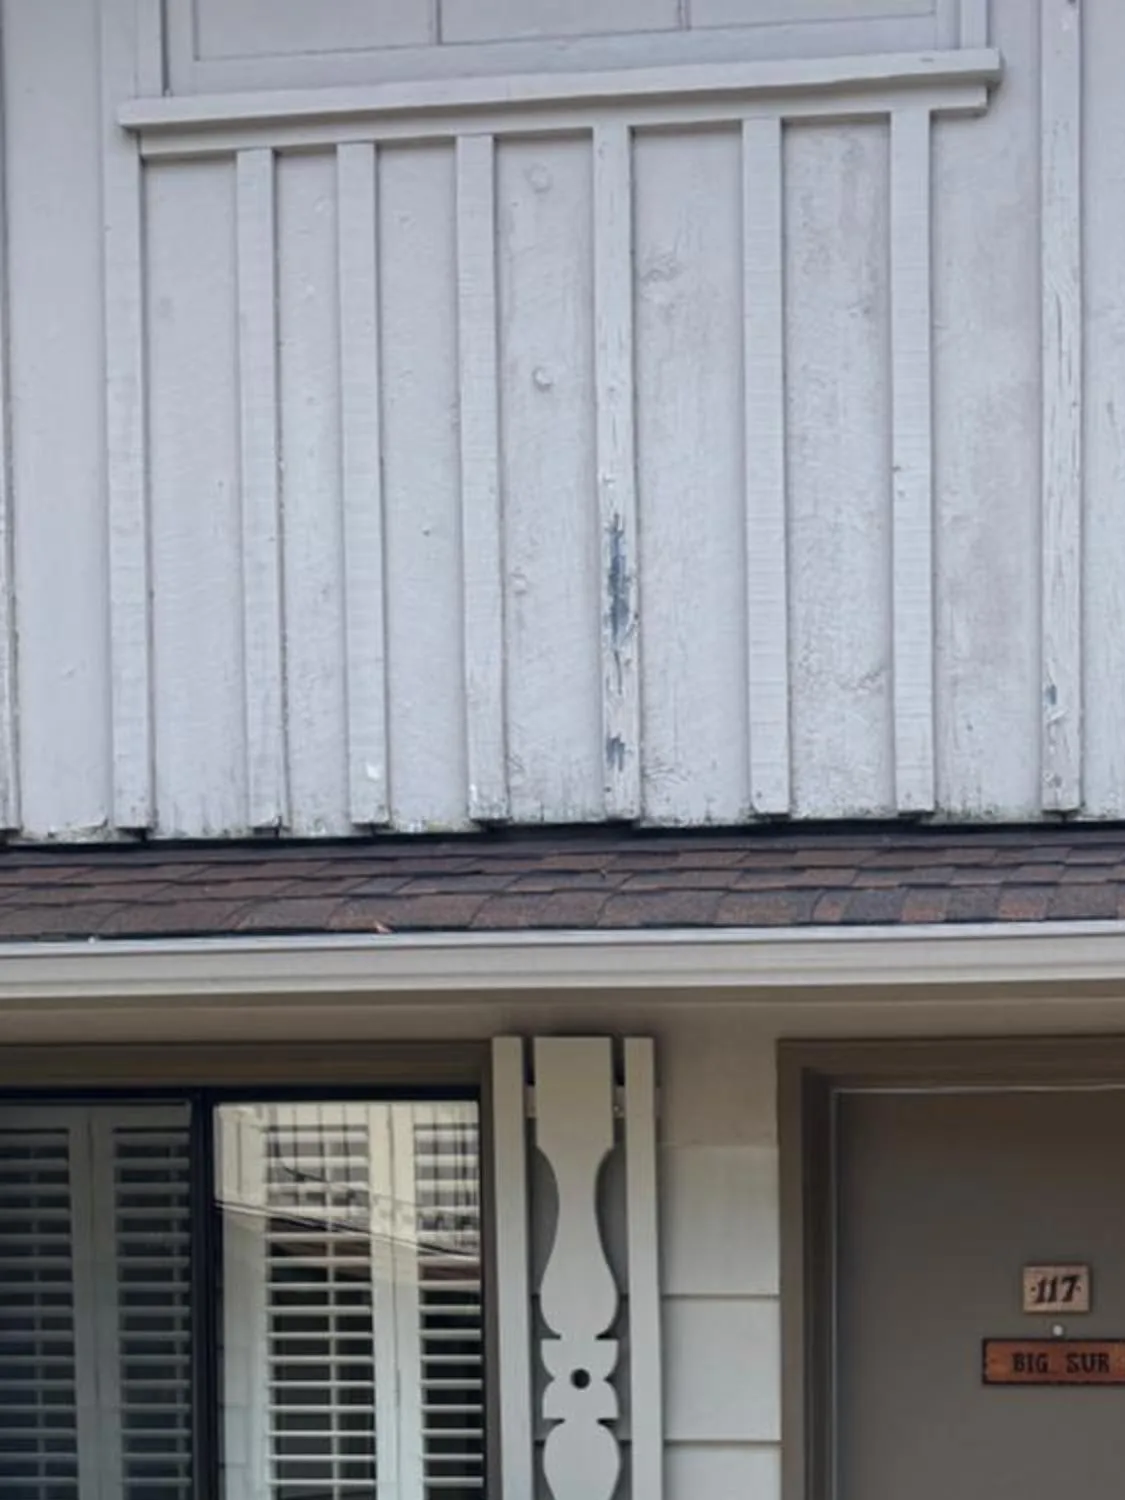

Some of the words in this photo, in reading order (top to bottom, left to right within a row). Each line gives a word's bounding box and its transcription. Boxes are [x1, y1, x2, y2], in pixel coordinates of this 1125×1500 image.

[1035, 1275, 1079, 1304] 117
[1012, 1352, 1049, 1373] BIG
[1066, 1352, 1110, 1373] SUR
